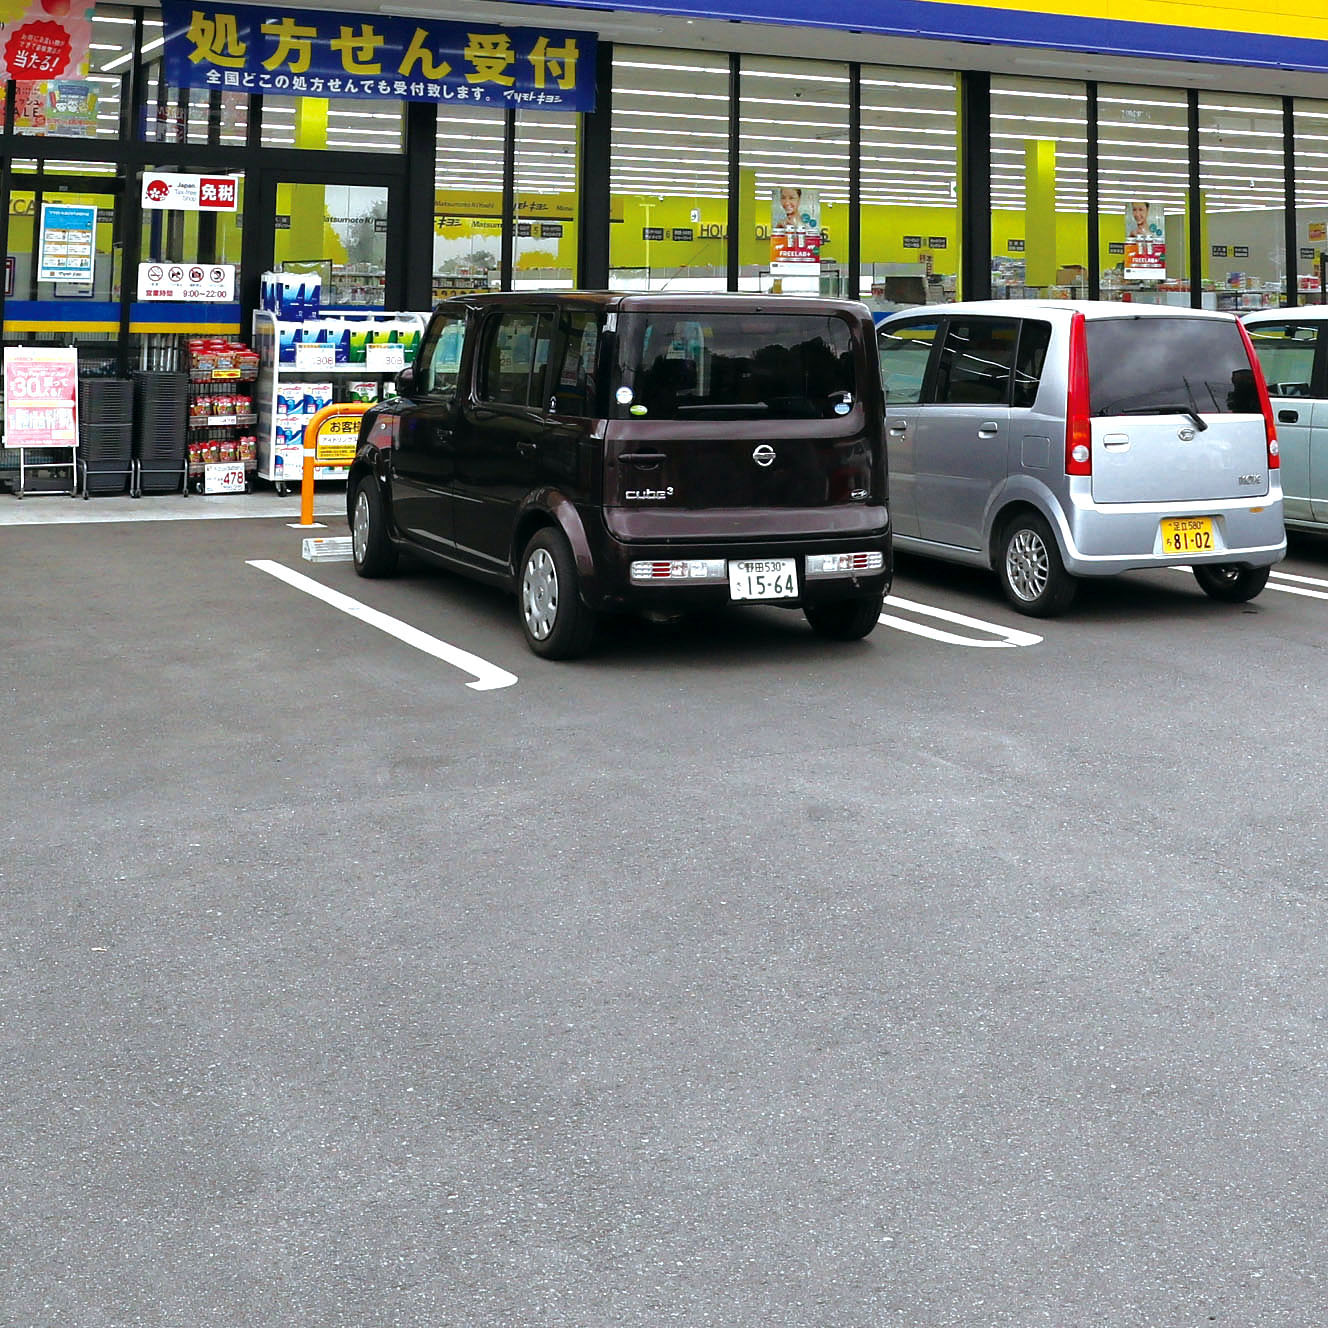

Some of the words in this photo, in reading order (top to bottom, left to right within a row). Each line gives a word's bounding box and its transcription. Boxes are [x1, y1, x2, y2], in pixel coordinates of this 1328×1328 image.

[186, 10, 579, 90] 処方せん受付
[205, 69, 492, 102] 全国どこの処方せんでも受付致します。
[201, 183, 234, 202] 免税
[223, 471, 245, 485] 478
